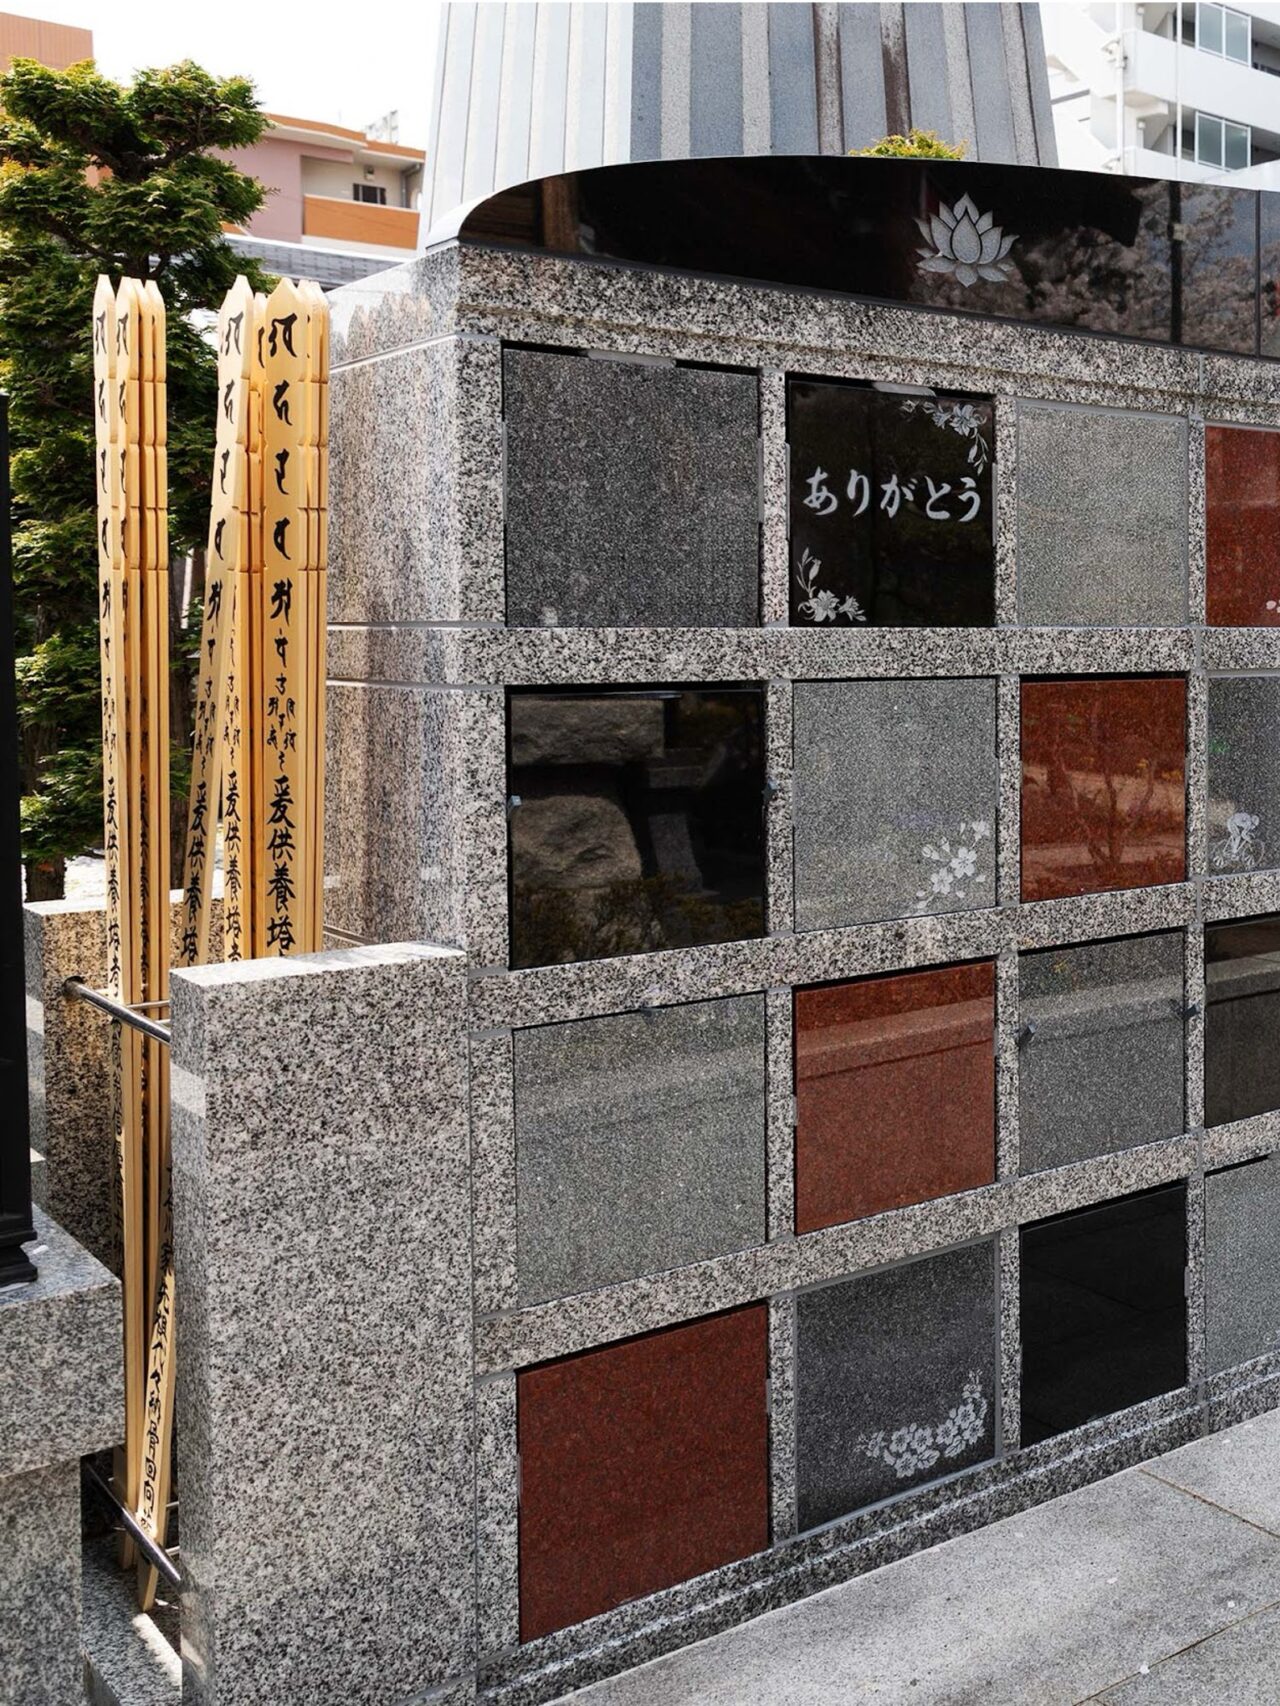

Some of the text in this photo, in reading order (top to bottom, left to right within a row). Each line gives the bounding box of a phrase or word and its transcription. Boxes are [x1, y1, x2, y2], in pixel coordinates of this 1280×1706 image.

[803, 466, 981, 522] ありがとう
